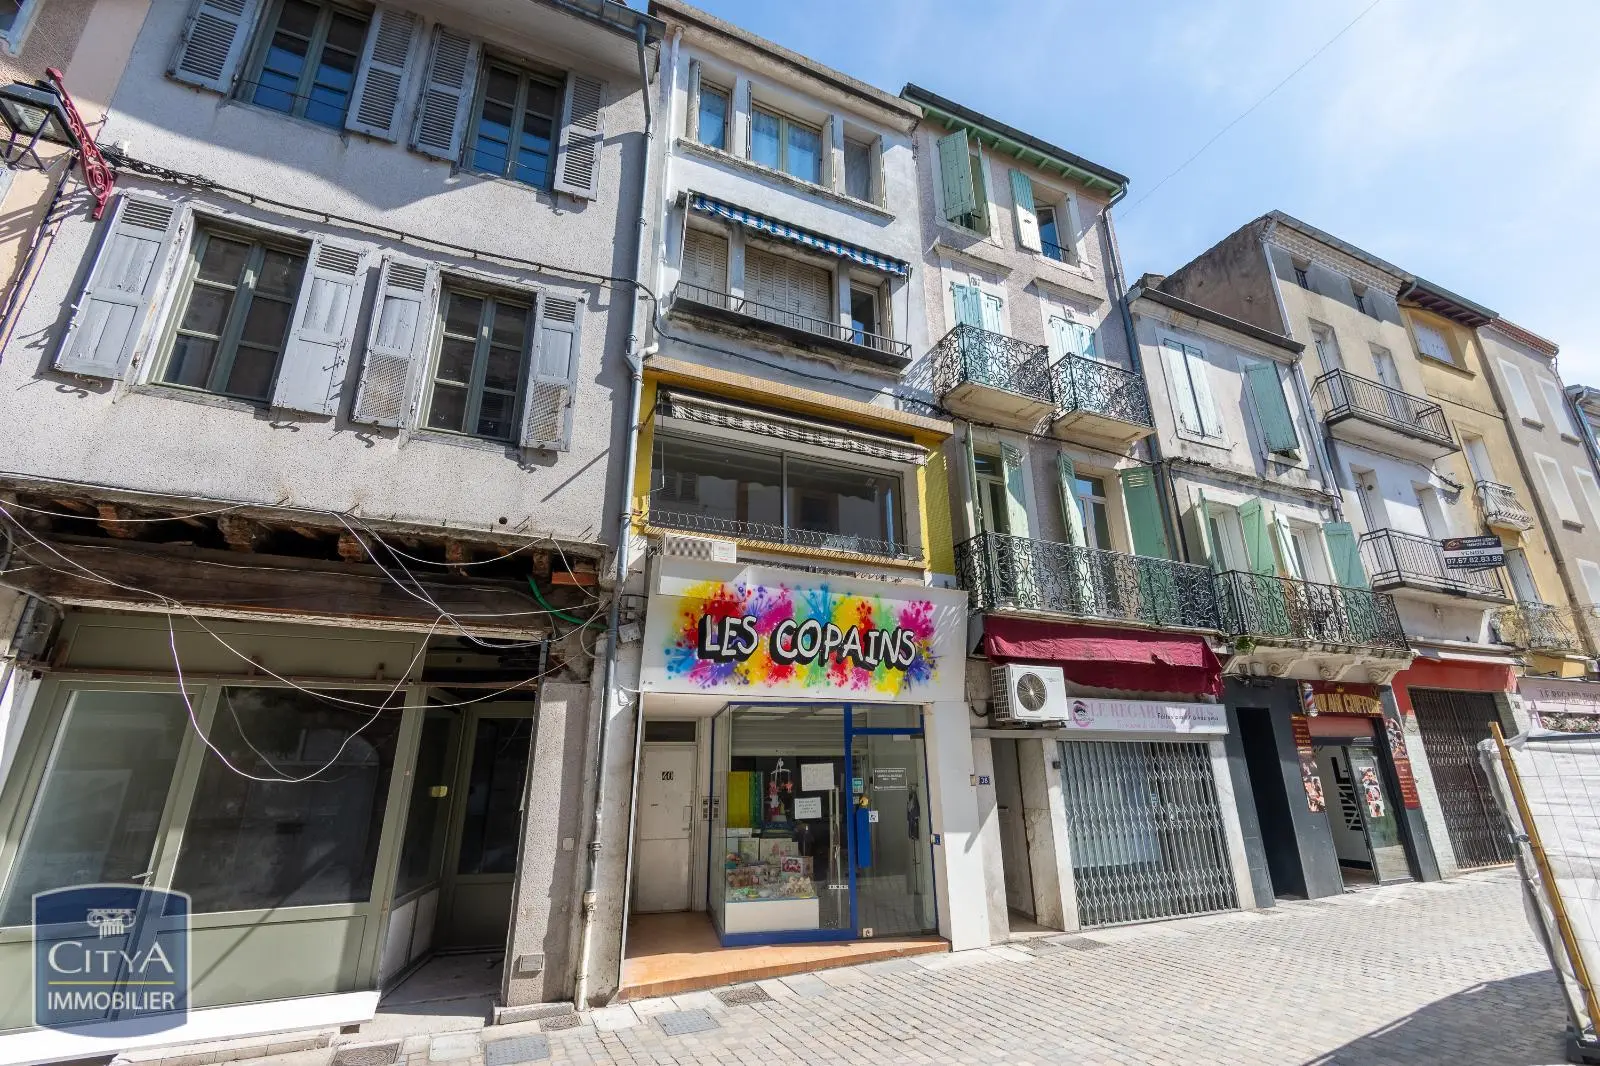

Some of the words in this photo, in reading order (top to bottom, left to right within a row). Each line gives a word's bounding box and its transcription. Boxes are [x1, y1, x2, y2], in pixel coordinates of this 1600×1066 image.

[702, 614, 758, 658] LES
[775, 619, 917, 667] COPAINS
[661, 771, 674, 781] 40
